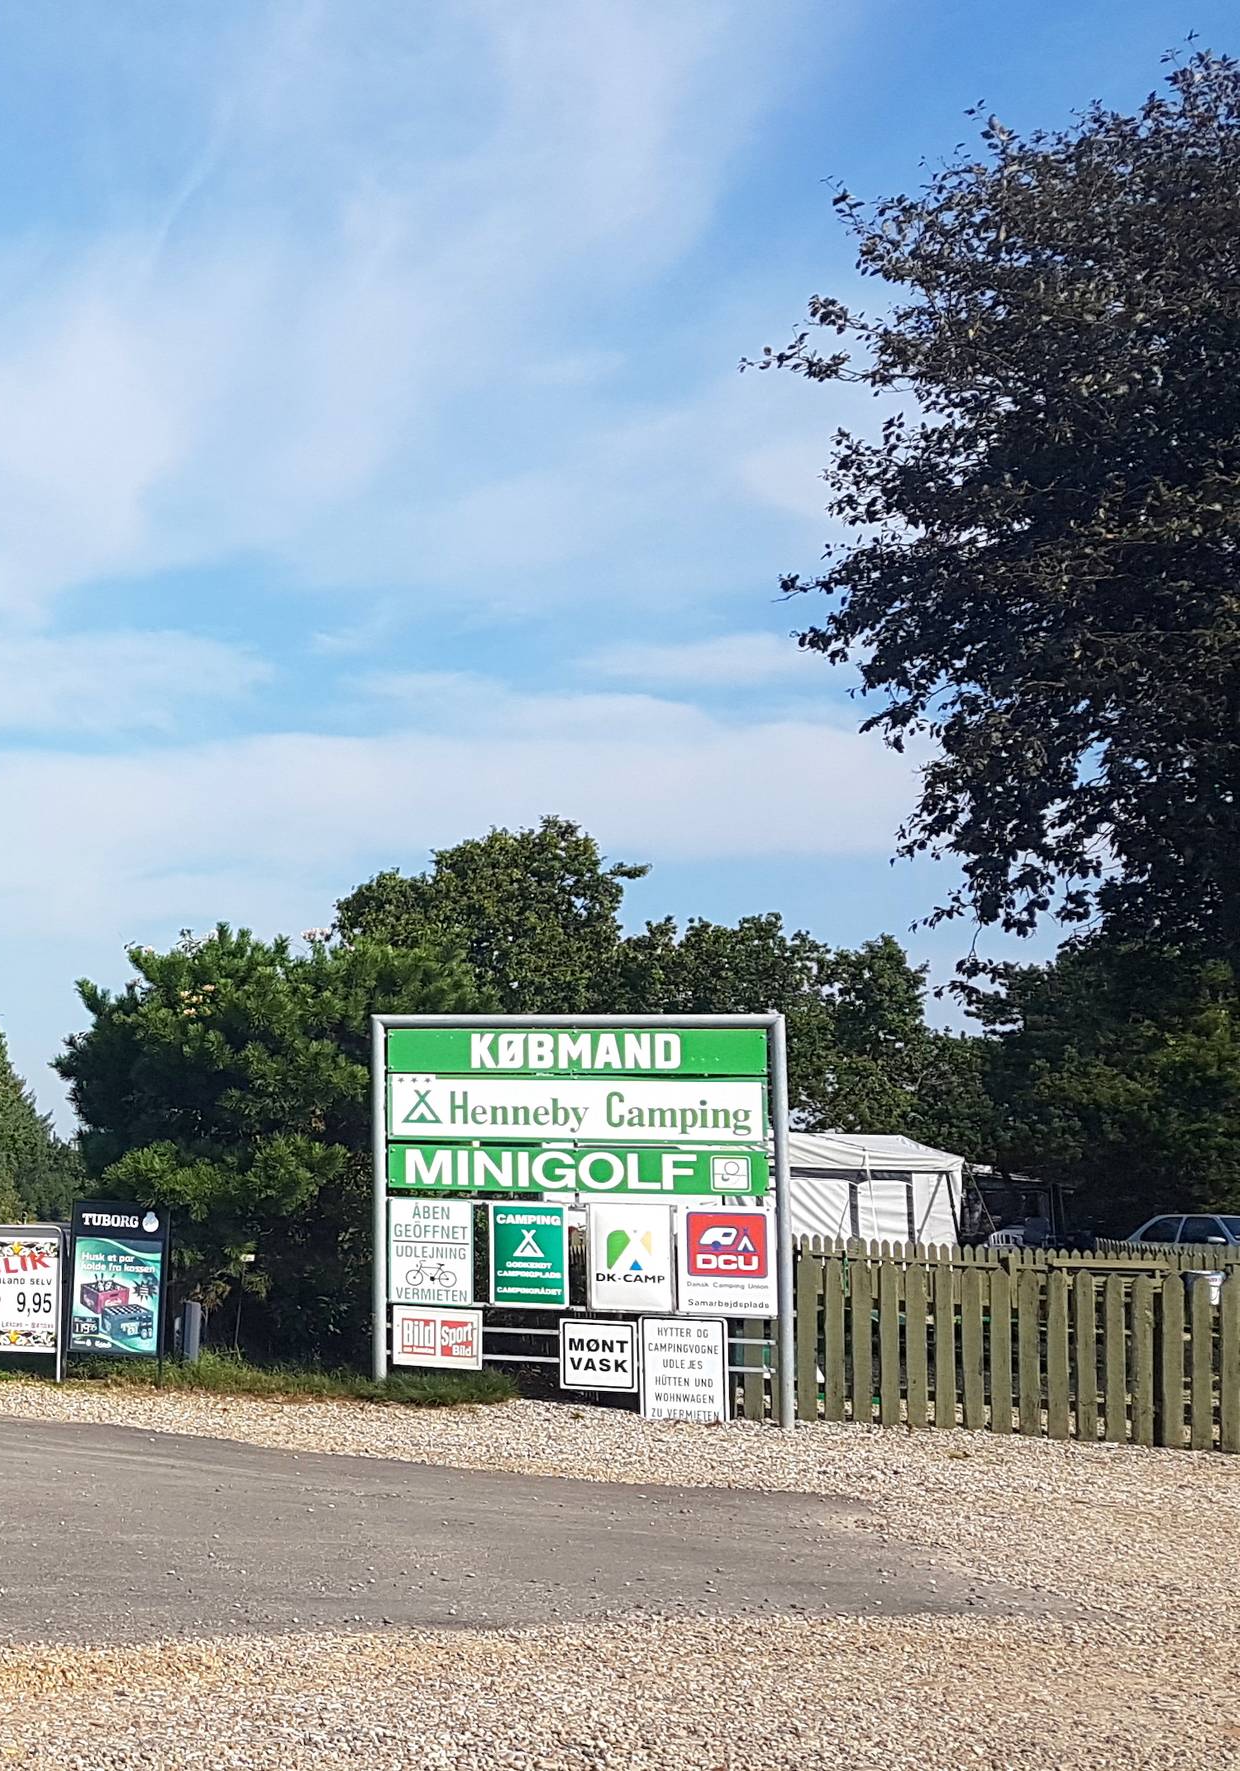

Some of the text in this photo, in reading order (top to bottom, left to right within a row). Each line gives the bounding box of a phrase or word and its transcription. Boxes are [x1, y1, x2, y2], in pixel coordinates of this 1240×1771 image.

[470, 1032, 681, 1070] KØBMAND
[450, 1090, 752, 1136] Henneby Camping
[405, 1148, 697, 1191] MINIGOLF
[412, 1202, 450, 1220] ÅBEN
[81, 1213, 139, 1228] TUBORG
[496, 1214, 561, 1226] CAMPING
[394, 1221, 469, 1240] GEÖFFNET
[81, 1252, 105, 1262] Husk
[118, 1255, 135, 1266] par
[396, 1245, 466, 1260] UDLEJNING
[695, 1253, 759, 1271] DCU
[29, 1278, 52, 1286] SELV
[595, 1272, 665, 1284] DK-CAMP
[712, 1281, 745, 1290] Camping
[748, 1282, 769, 1290] Union
[396, 1287, 467, 1302] VERMIETEN
[16, 1291, 52, 1317] 9,95
[687, 1298, 770, 1309] Samarbejdsplads
[403, 1319, 435, 1347] Bild
[657, 1327, 709, 1339] HYTTER OG
[452, 1345, 472, 1356] Bild
[568, 1337, 629, 1353] MØNT
[647, 1342, 719, 1355] CAMPINGVOGNE
[569, 1357, 629, 1373] VASK
[654, 1374, 714, 1388] HÜTTEN UND
[654, 1392, 715, 1404] WOHNWAGEN
[651, 1407, 720, 1422] ZU VERMIETEN
